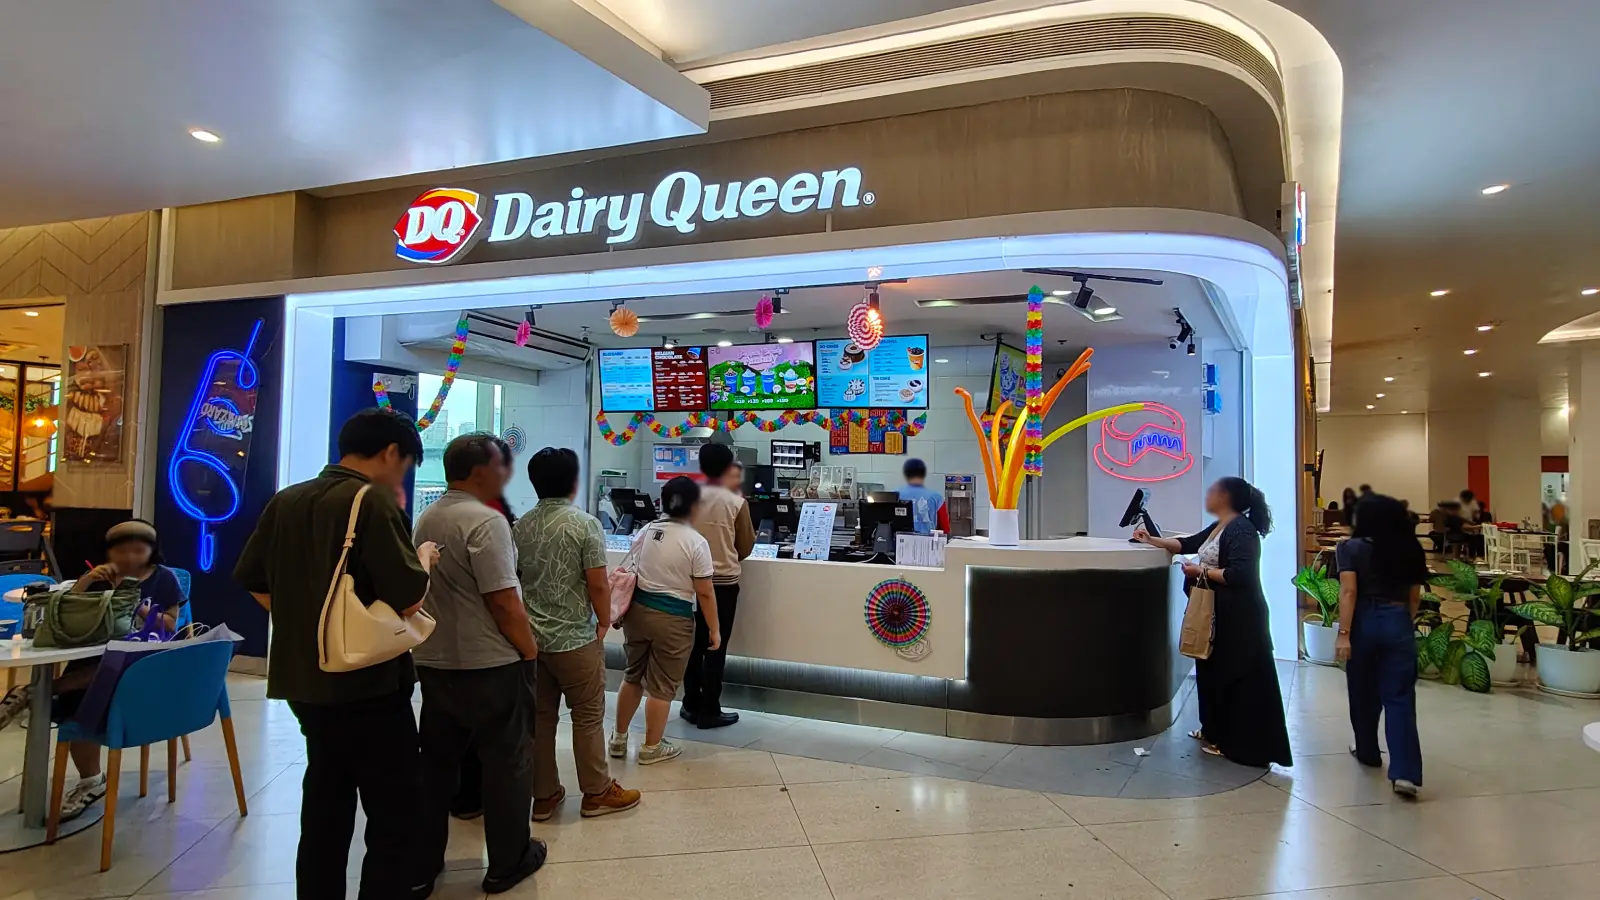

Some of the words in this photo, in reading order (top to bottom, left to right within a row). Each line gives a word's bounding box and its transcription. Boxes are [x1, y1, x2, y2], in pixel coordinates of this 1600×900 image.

[404, 201, 465, 244] DQ
[488, 187, 644, 244] Dairy
[651, 167, 862, 234] Queen
